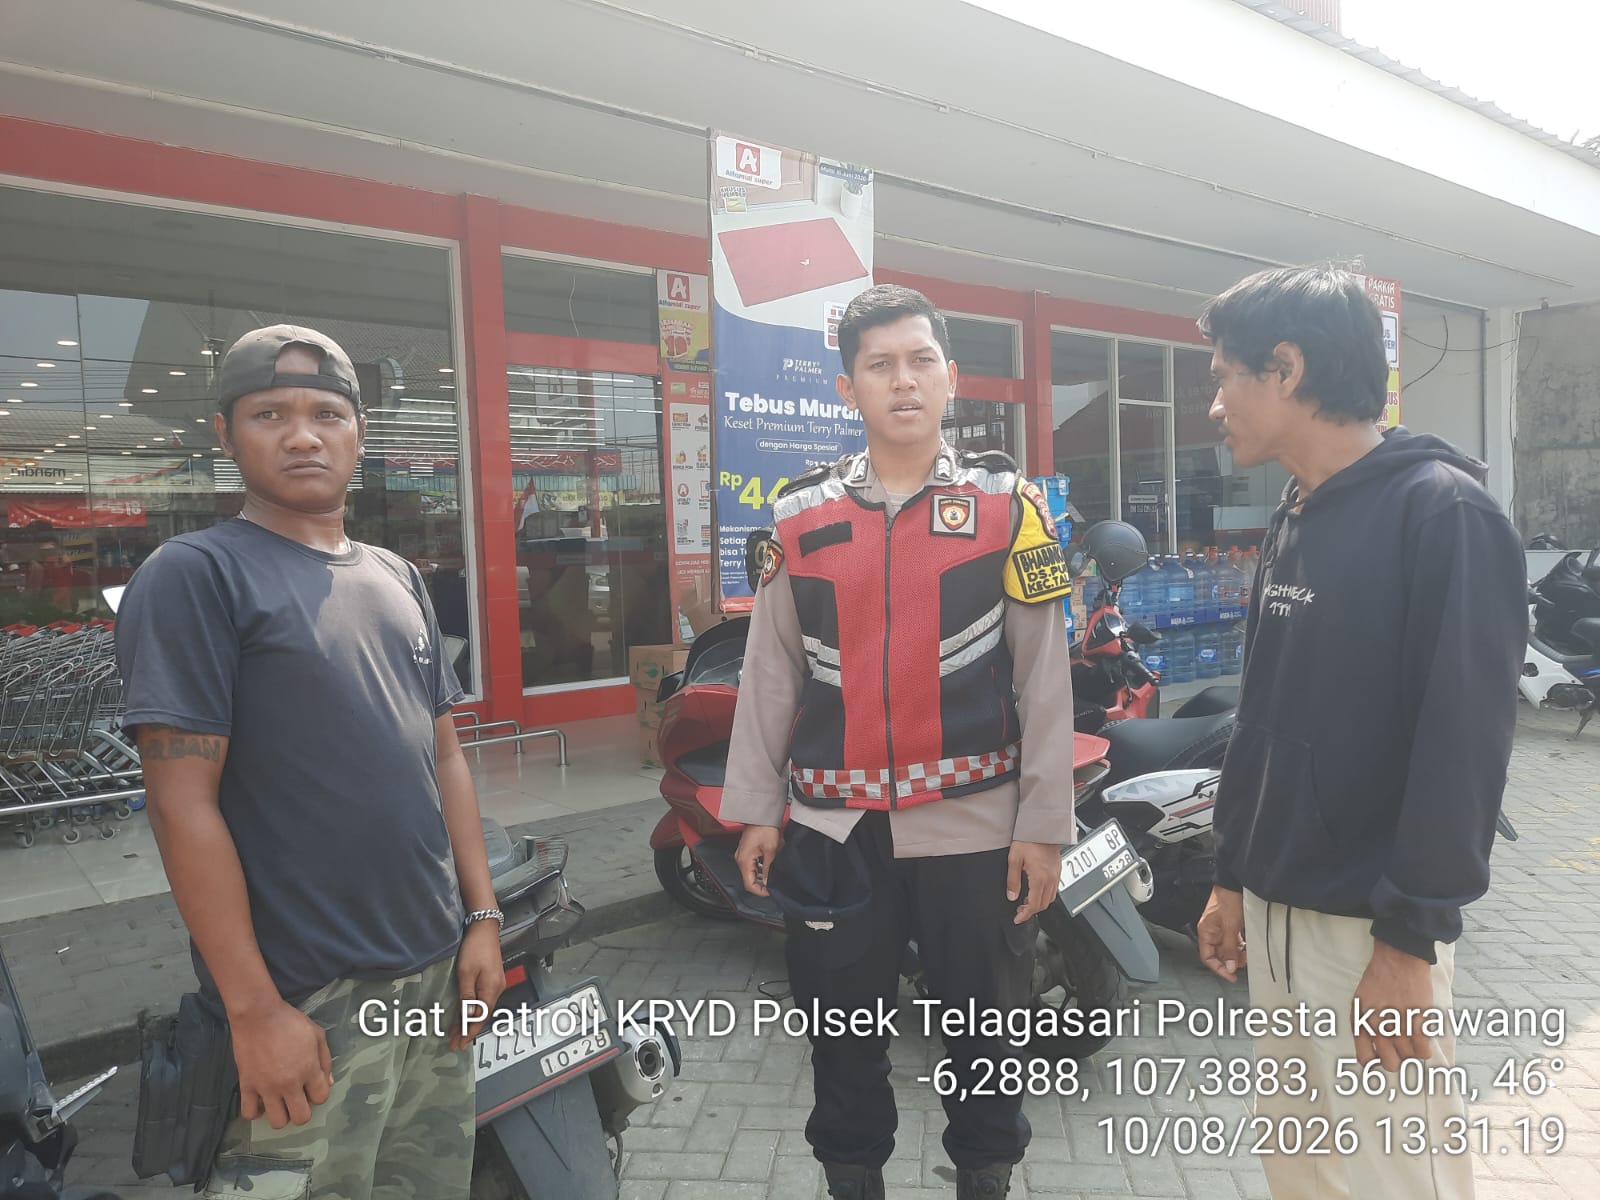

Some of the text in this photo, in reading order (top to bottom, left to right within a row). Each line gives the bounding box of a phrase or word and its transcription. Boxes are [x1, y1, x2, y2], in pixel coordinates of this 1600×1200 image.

[1368, 278, 1395, 295] PARKIR
[724, 391, 795, 415] Tebus
[723, 415, 864, 438] Keset Premium Terry Palmer
[759, 440, 788, 450] dengan
[789, 442, 812, 451] Harga
[1066, 846, 1098, 879] 2101
